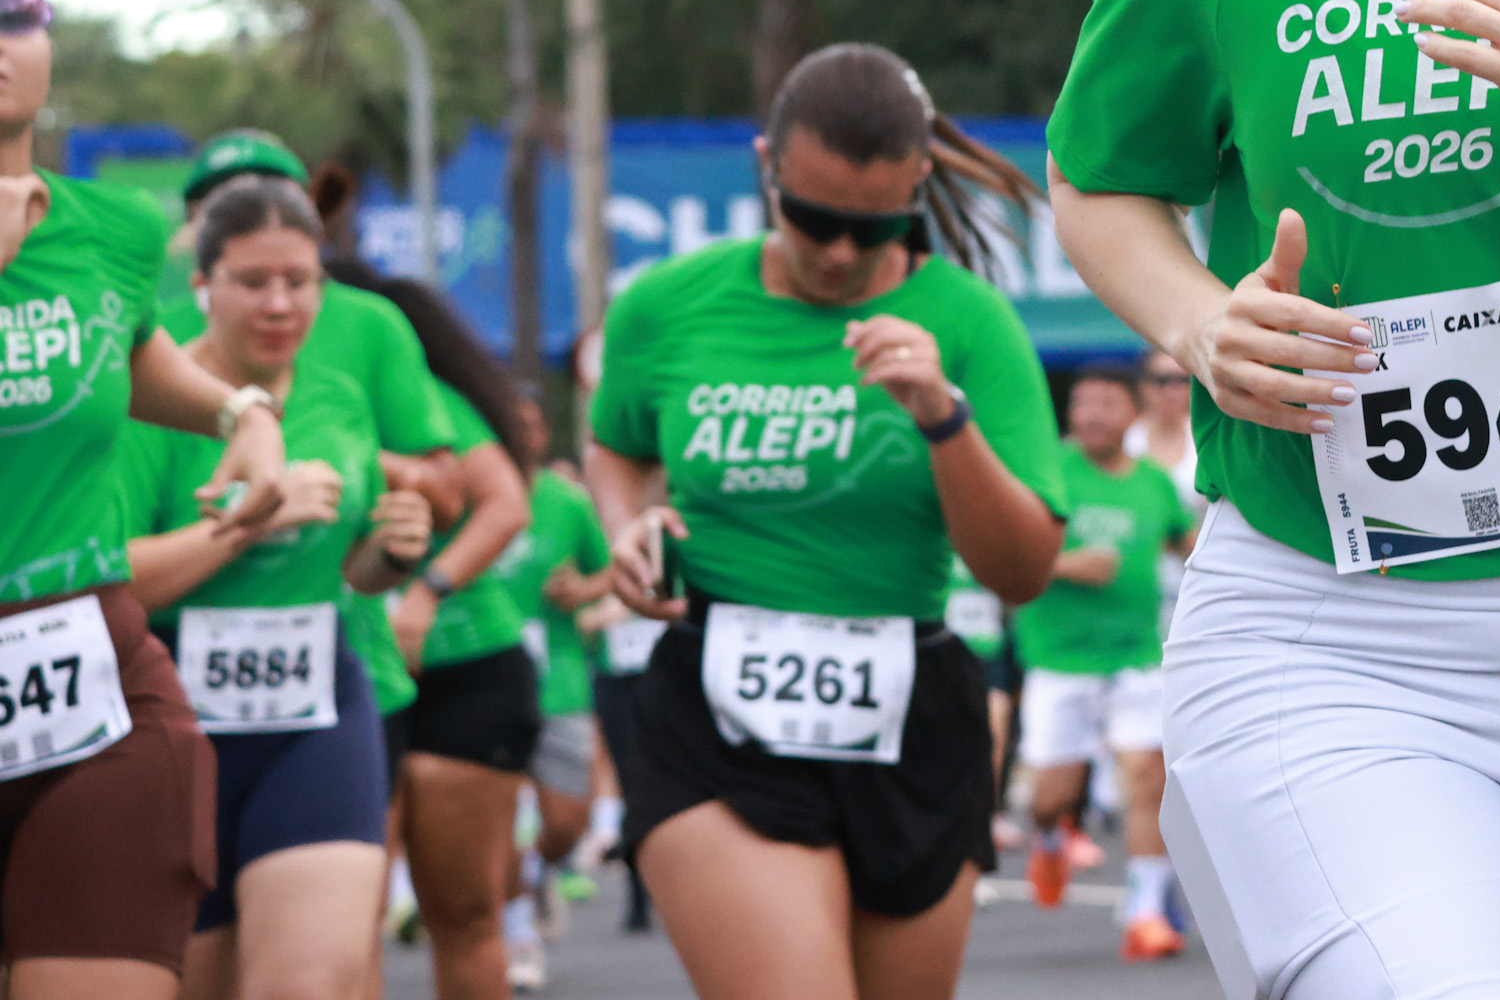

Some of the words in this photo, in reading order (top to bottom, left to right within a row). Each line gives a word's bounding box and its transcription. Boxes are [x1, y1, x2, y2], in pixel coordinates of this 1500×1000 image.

[1364, 127, 1493, 183] 2026
[1390, 317, 1426, 334] ALEPI
[0, 321, 82, 373] EPI
[1375, 351, 1389, 371] K
[687, 383, 857, 416] CORRIDA
[683, 415, 857, 463] ALEPI
[1337, 492, 1352, 518] 5944
[1347, 528, 1361, 563] FRUTA
[206, 646, 311, 690] 5884
[737, 653, 879, 709] 5261
